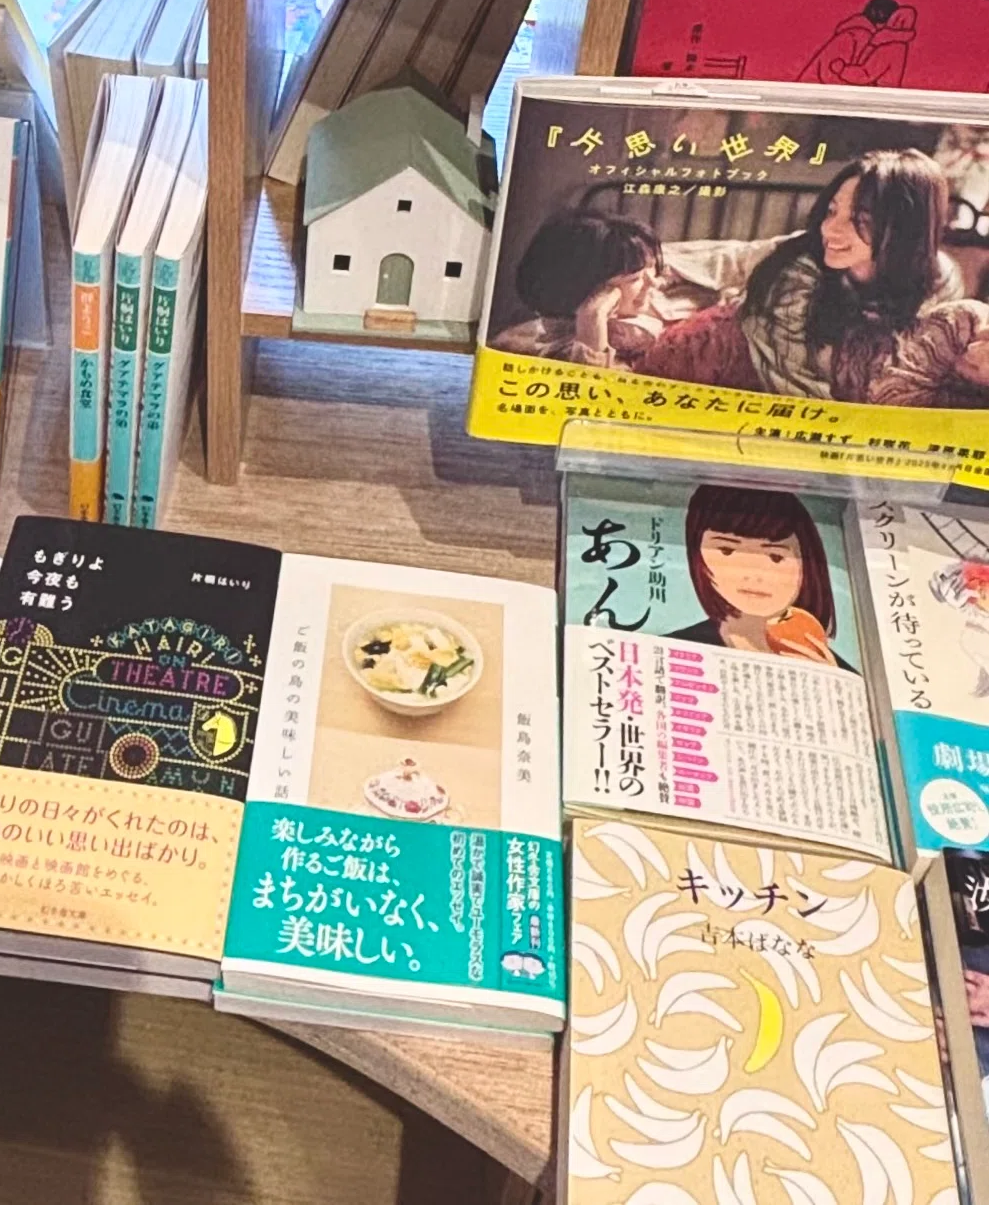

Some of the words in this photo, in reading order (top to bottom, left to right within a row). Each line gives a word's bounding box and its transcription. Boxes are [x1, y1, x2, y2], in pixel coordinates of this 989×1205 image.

[547, 125, 829, 167] 『片思い世界』
[587, 163, 770, 183] オフィシャルフォトブック
[498, 378, 841, 425] この思い、あなたに届け。
[26, 569, 80, 590] 今夜も
[33, 548, 105, 572] もぎりよ
[580, 517, 652, 633] あん
[647, 516, 667, 604] ドリアン助川
[19, 590, 75, 612] 有難う
[867, 500, 933, 711] スクリーンが待っている
[111, 660, 231, 696] THEATRE
[273, 625, 311, 800] ご飯の島の美味しい話
[615, 640, 647, 797] 日本発・世界の
[516, 711, 532, 784] 飯島奈美
[270, 817, 401, 858] 楽しみながら
[280, 846, 401, 888] 作るご飯は、
[251, 871, 440, 934] まちがいなく、
[675, 867, 829, 919] キッチン
[275, 914, 422, 973] 美味しい。
[699, 922, 817, 962] 吉本ばなな
